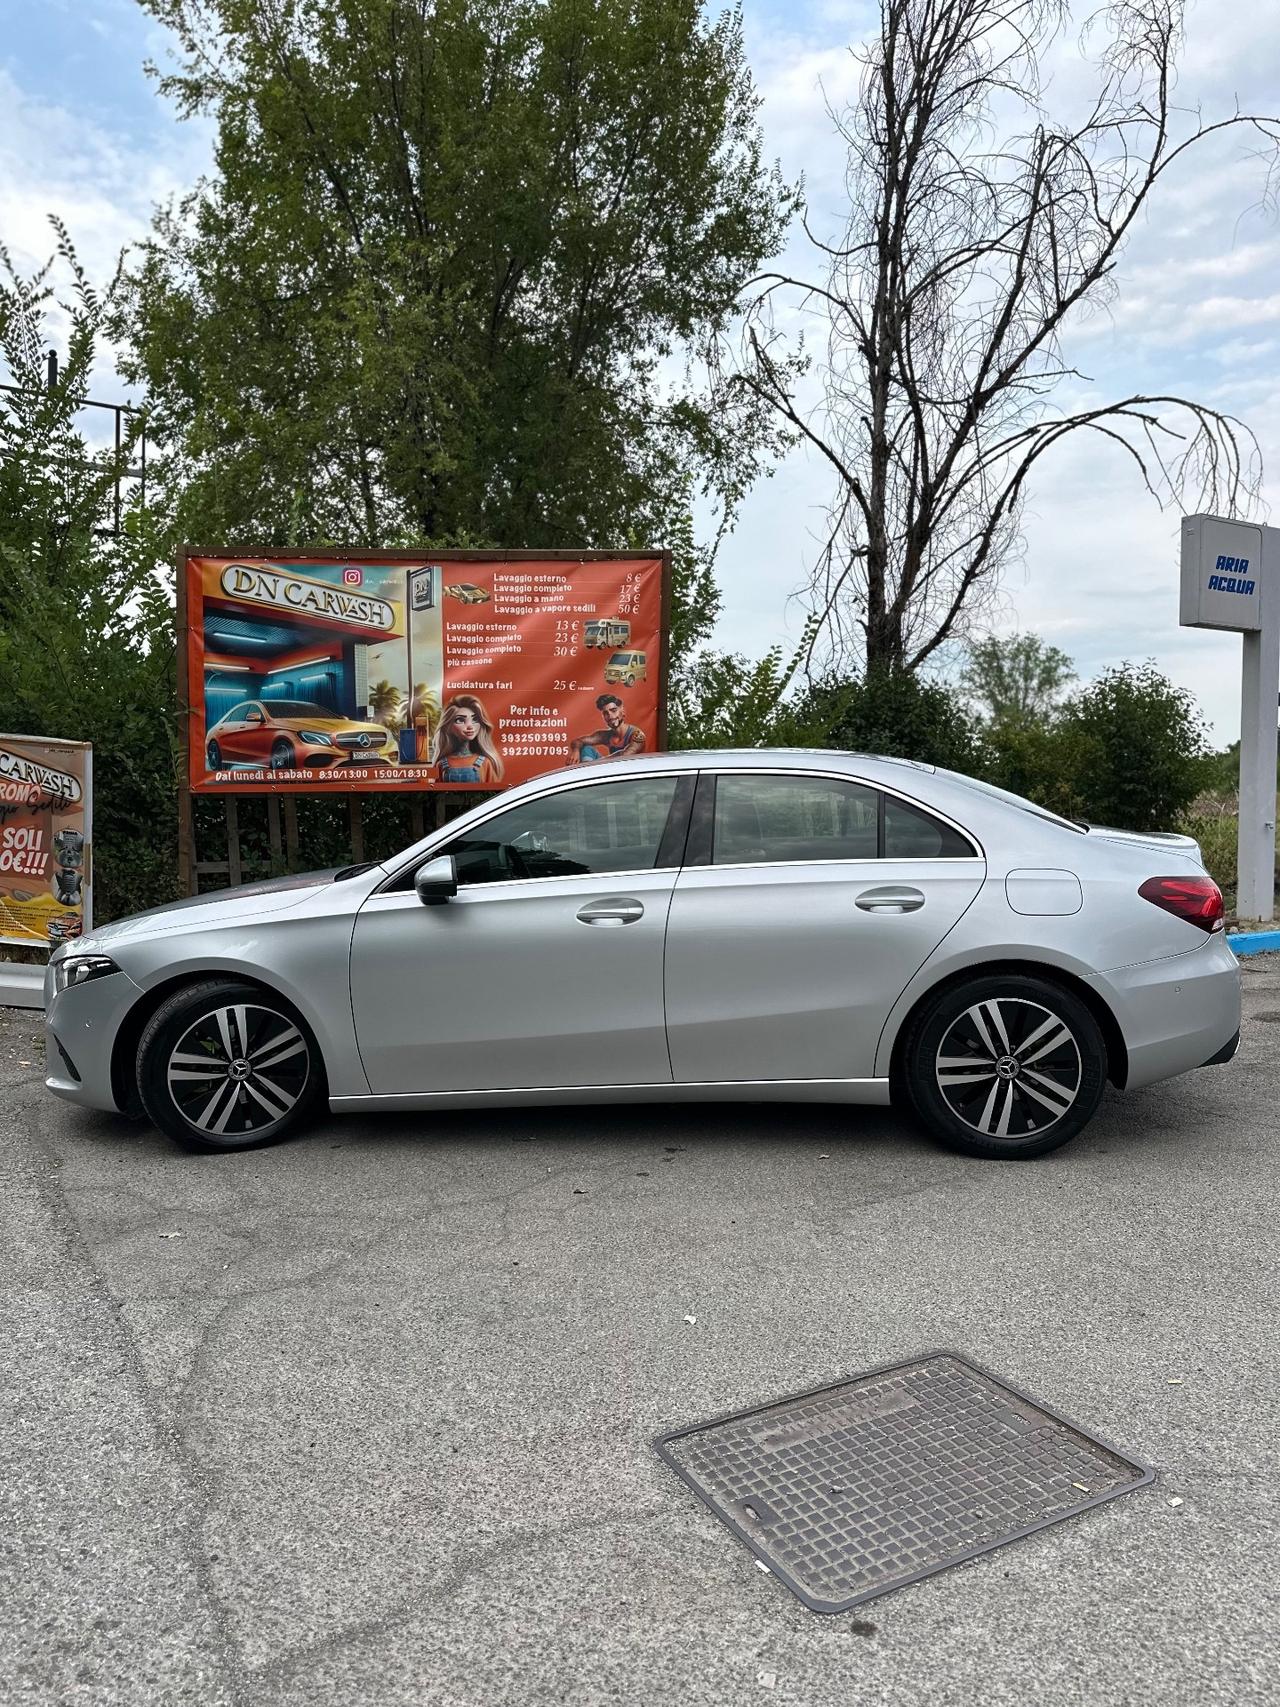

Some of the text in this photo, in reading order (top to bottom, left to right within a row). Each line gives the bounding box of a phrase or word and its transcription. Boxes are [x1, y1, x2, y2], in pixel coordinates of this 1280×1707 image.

[1216, 555, 1250, 574] ARIA
[494, 573, 641, 583] Lavaggio esterno 8 €
[494, 584, 641, 594] Lavaggio completo 17 €
[1208, 575, 1256, 595] ACQUA
[234, 569, 385, 626] DN CARWASH
[494, 594, 532, 603] Lavaggio
[541, 595, 564, 603] mano
[619, 594, 631, 603] 23
[633, 594, 640, 603] €
[494, 605, 533, 615] Lavaggio
[542, 604, 571, 613] vapore
[573, 604, 596, 612] sedili
[618, 605, 630, 613] 50
[632, 605, 640, 614] €
[446, 622, 483, 632] Lavaggio
[556, 621, 569, 630] 13
[571, 620, 579, 630] €
[446, 632, 579, 644] Lavaggio completo 23 €
[446, 646, 578, 656] Lavaggio completo 30 €
[447, 658, 492, 667] più cassone
[496, 681, 512, 689] fari
[553, 680, 566, 690] 25
[568, 680, 576, 690] €
[510, 704, 527, 715] Per
[530, 706, 550, 715] info
[499, 718, 567, 729] prenotazioni
[501, 733, 567, 742] 3932503993
[502, 746, 569, 756] 3922007095
[0, 754, 74, 797] CARWASH
[216, 769, 427, 781] Dal lunedì al sabato 8:30/13:00 15:00/18:30
[2, 827, 43, 851] SOLI
